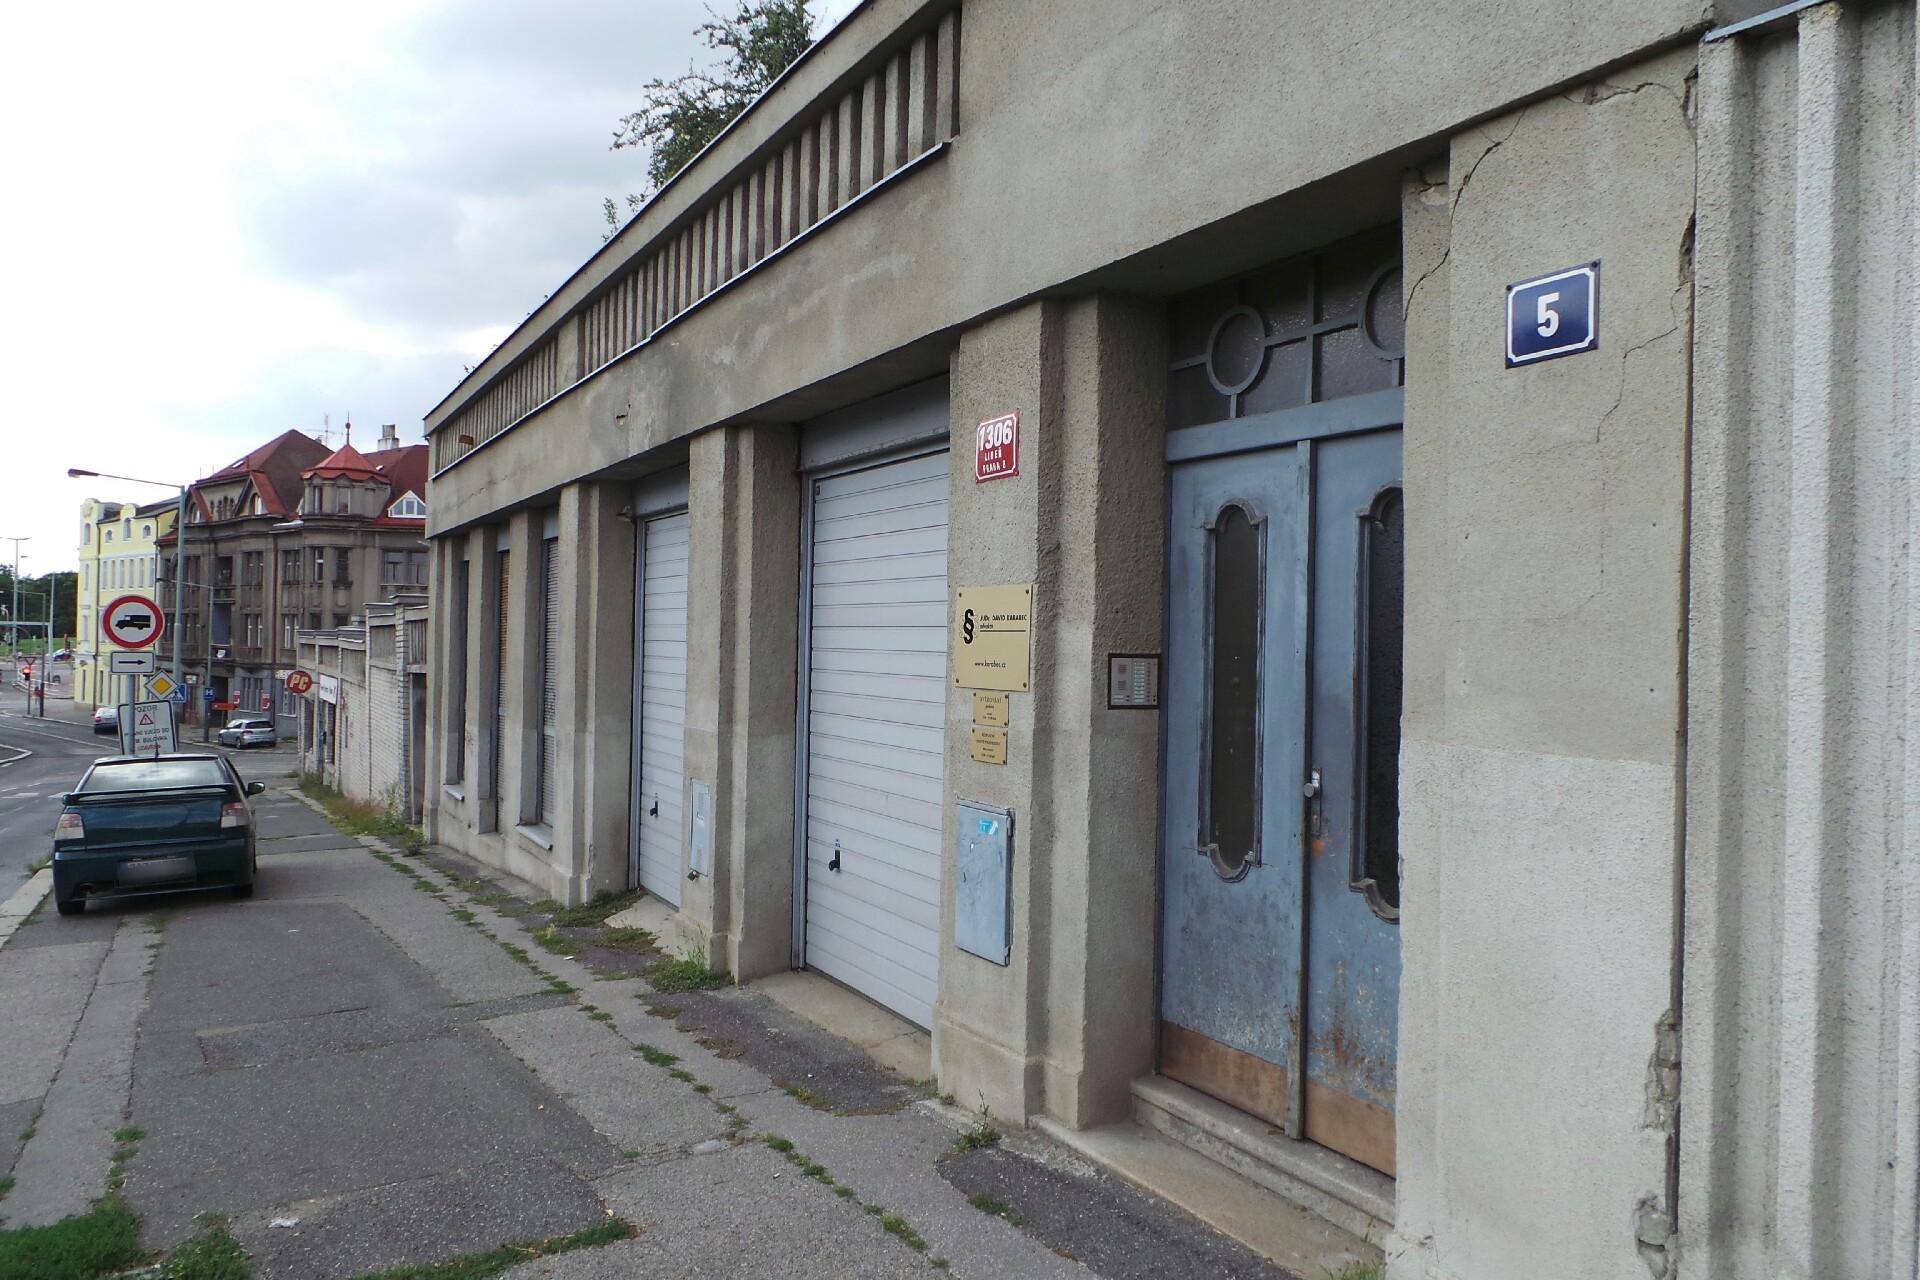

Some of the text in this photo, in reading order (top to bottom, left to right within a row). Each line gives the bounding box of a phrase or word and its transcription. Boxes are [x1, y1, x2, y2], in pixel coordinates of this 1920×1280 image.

[1537, 292, 1560, 337] 5
[980, 419, 1012, 451] 1306
[982, 461, 1001, 473] PRAHA
